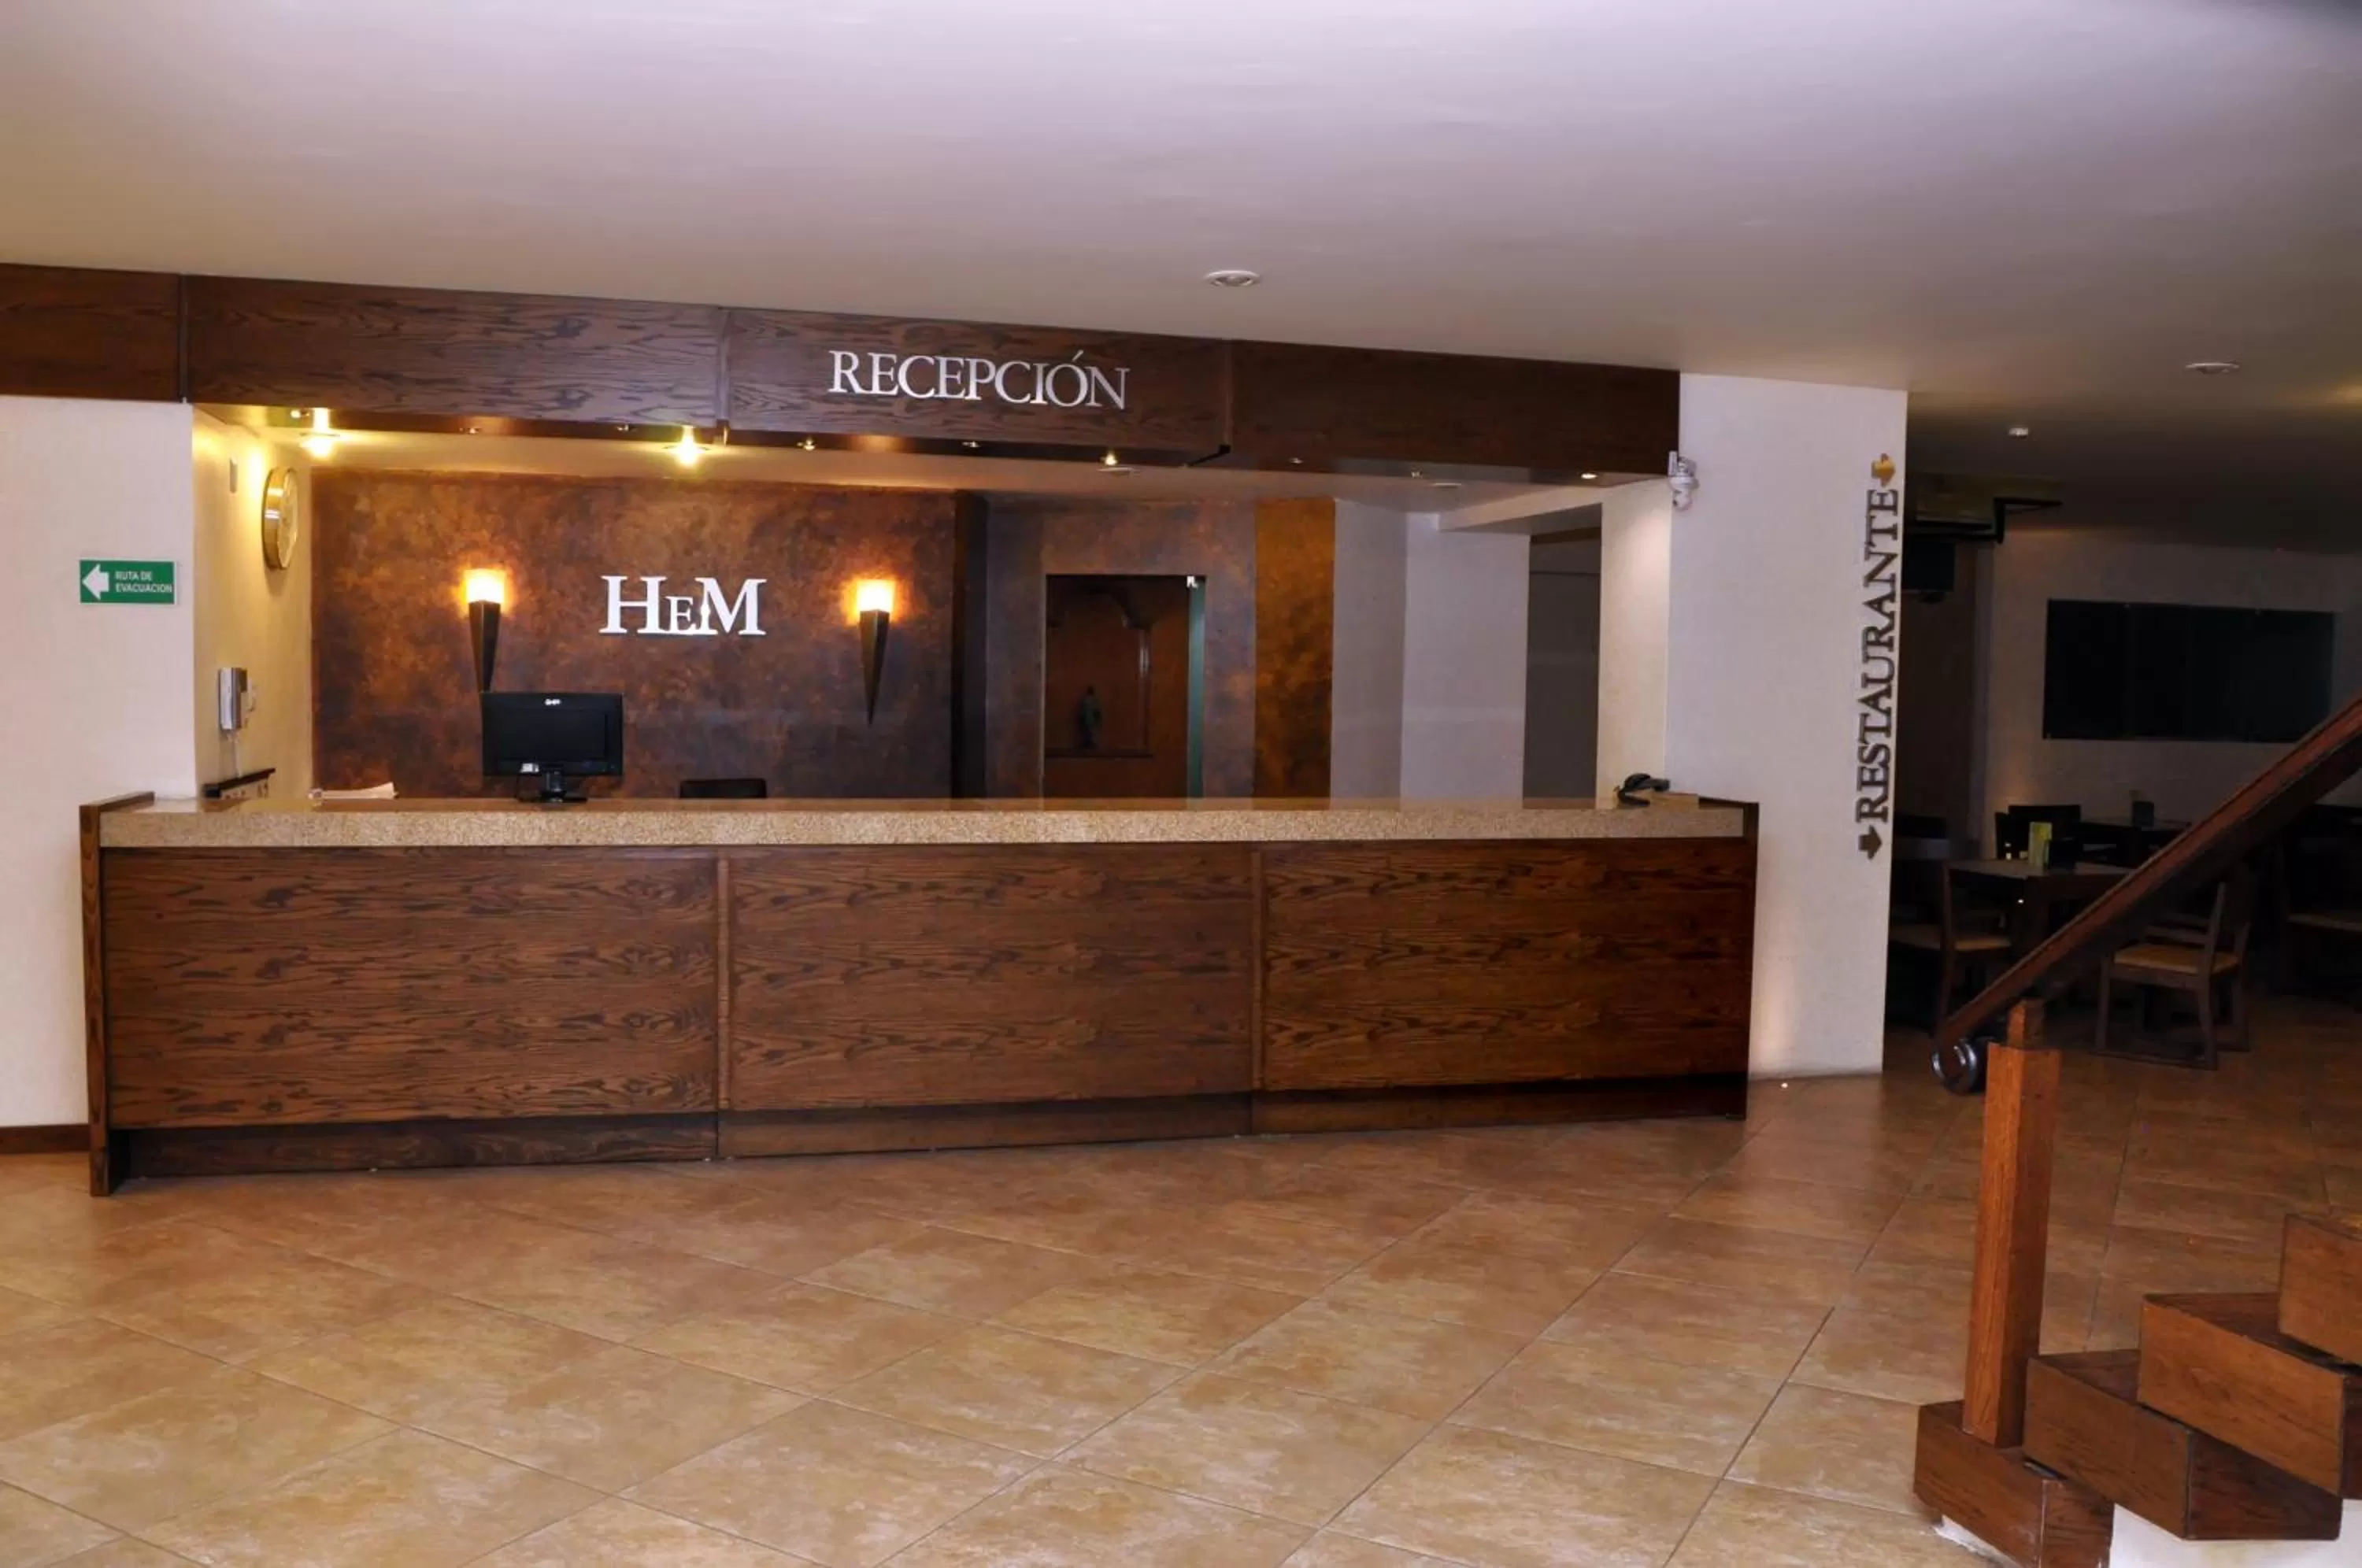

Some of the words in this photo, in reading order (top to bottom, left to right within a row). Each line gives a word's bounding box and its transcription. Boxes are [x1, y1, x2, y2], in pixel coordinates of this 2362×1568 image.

[827, 349, 1131, 410] RECEPCIÓN
[115, 571, 139, 580] RUTA
[140, 571, 153, 581] DE
[1855, 488, 1900, 823] RESTAURANTE
